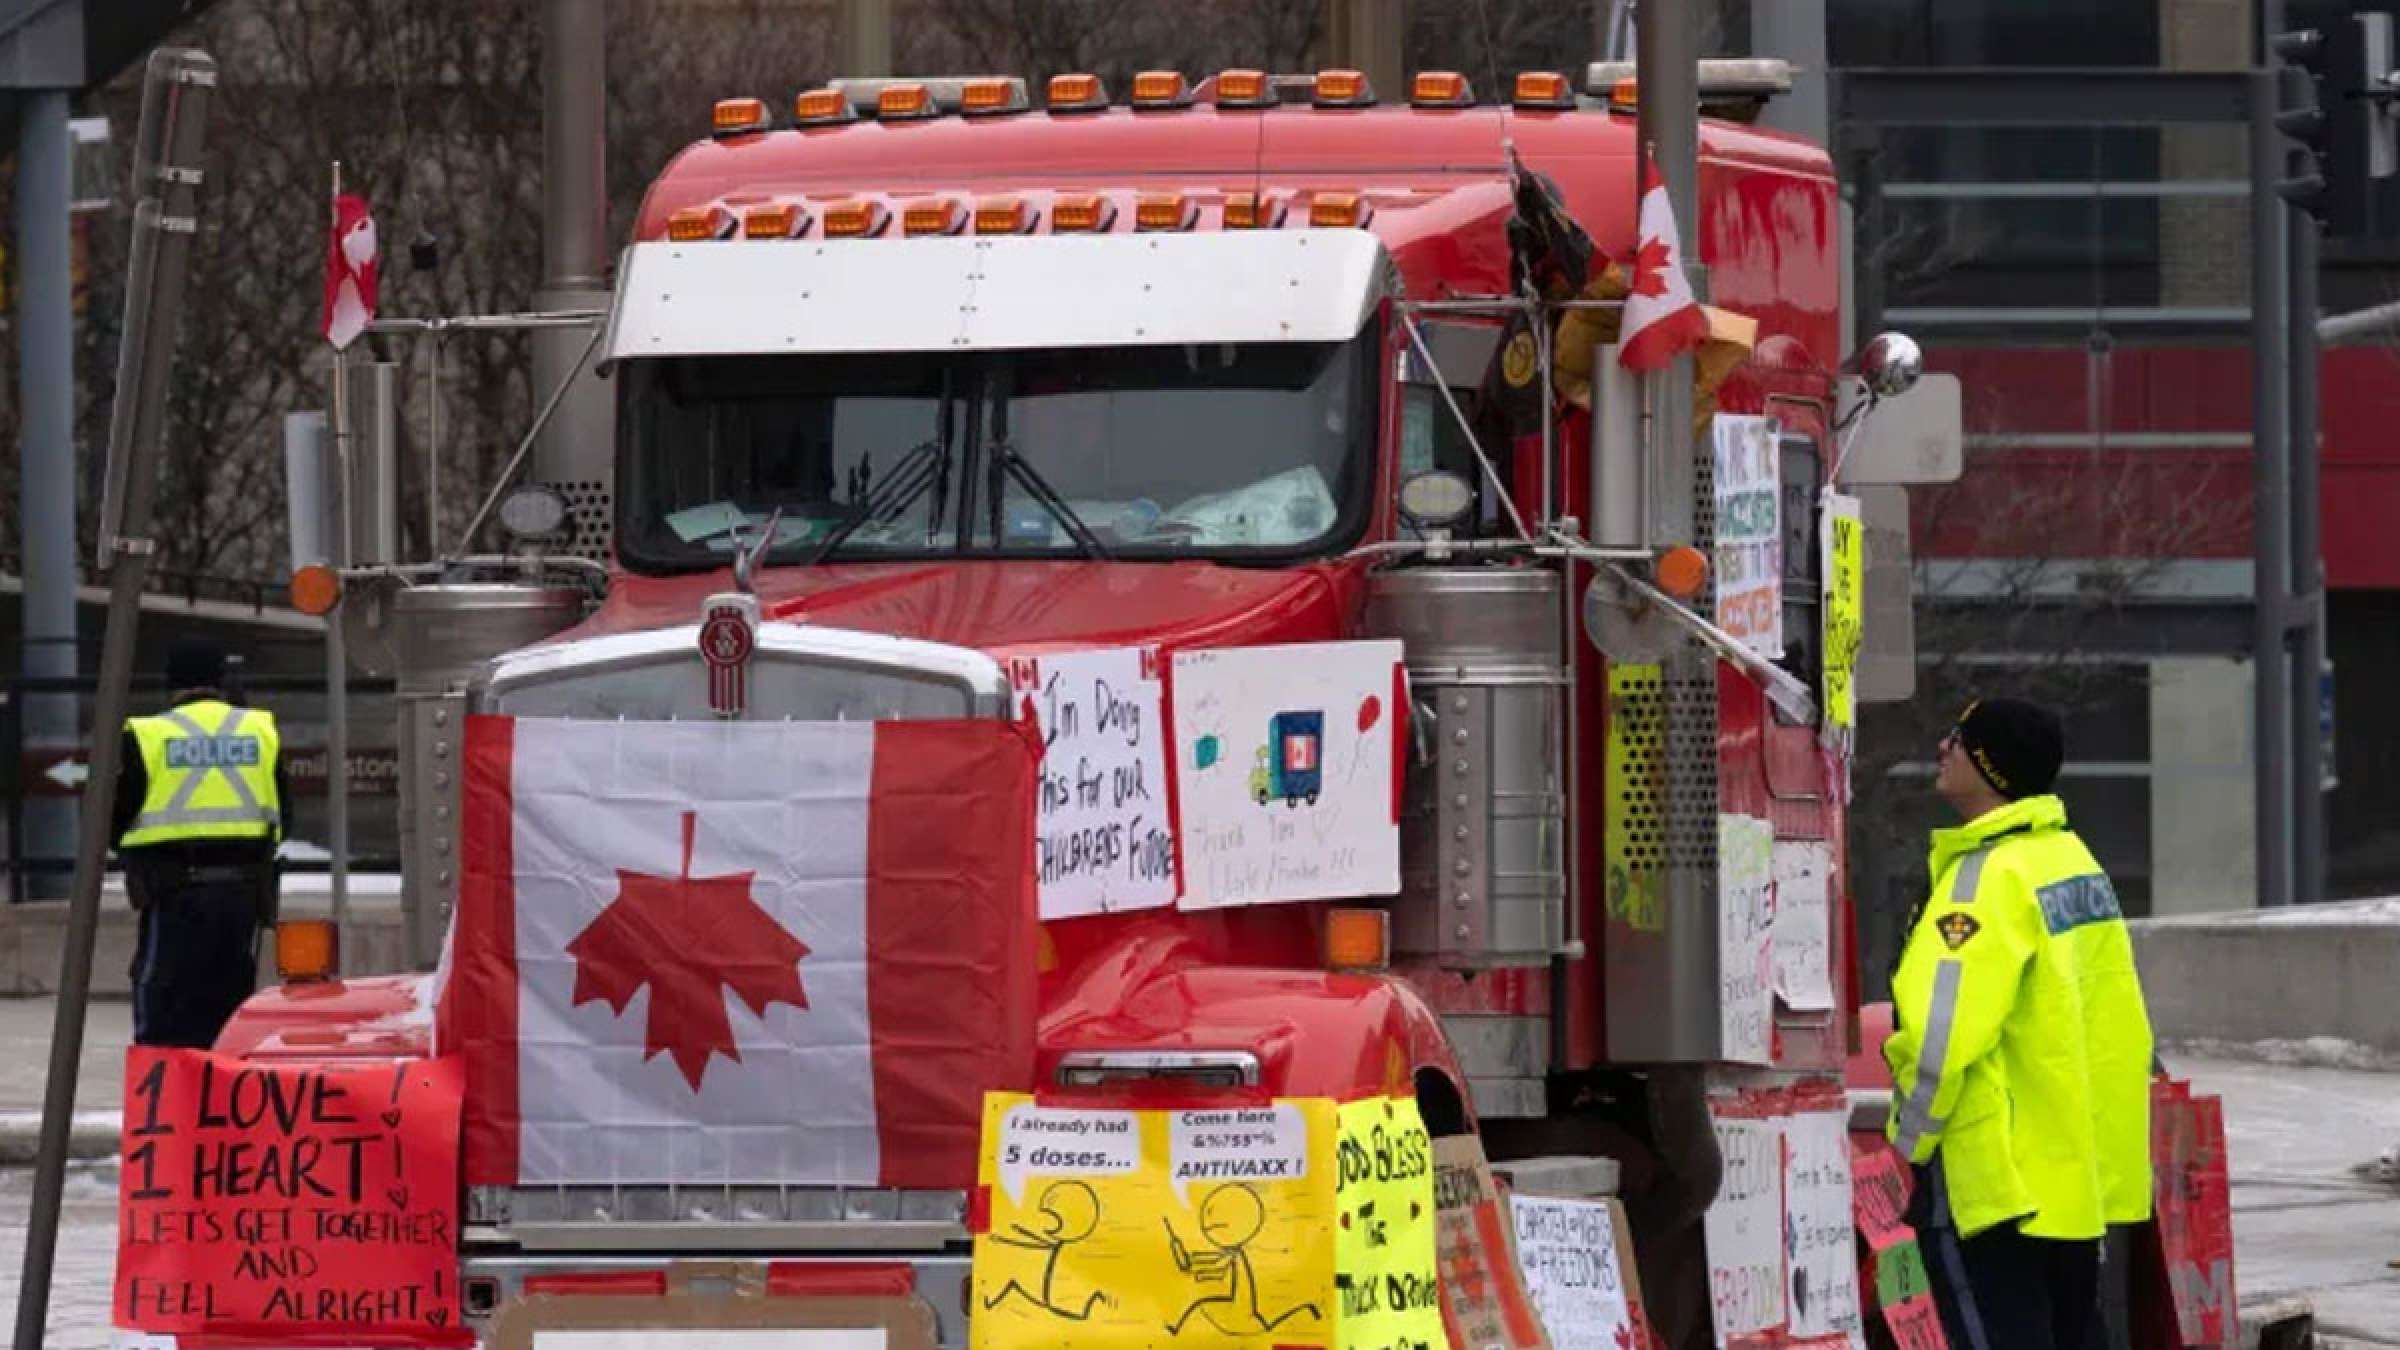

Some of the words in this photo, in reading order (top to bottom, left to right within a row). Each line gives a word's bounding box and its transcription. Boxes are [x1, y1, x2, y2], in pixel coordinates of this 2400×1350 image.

[1043, 671, 1078, 747] I'm
[1095, 678, 1141, 747] Doing
[168, 738, 259, 765] POLICE
[1076, 756, 1103, 809] for
[2041, 877, 2118, 929] POLICE
[131, 1060, 174, 1136] 1
[1012, 1117, 1018, 1129] I
[1021, 1116, 1090, 1136] already
[1095, 1118, 1129, 1133] had
[1181, 1111, 1232, 1127] Come
[1237, 1108, 1277, 1124] here
[128, 1140, 173, 1198] 1
[1005, 1144, 1020, 1165] 5
[1029, 1146, 1132, 1168] doses...
[1176, 1160, 1288, 1179] ANTIVAXX
[128, 1208, 224, 1245] LET'S
[234, 1208, 292, 1246] GET
[308, 1208, 449, 1245] TOGETHER
[233, 1247, 319, 1280] AND
[129, 1277, 233, 1320] FEEL
